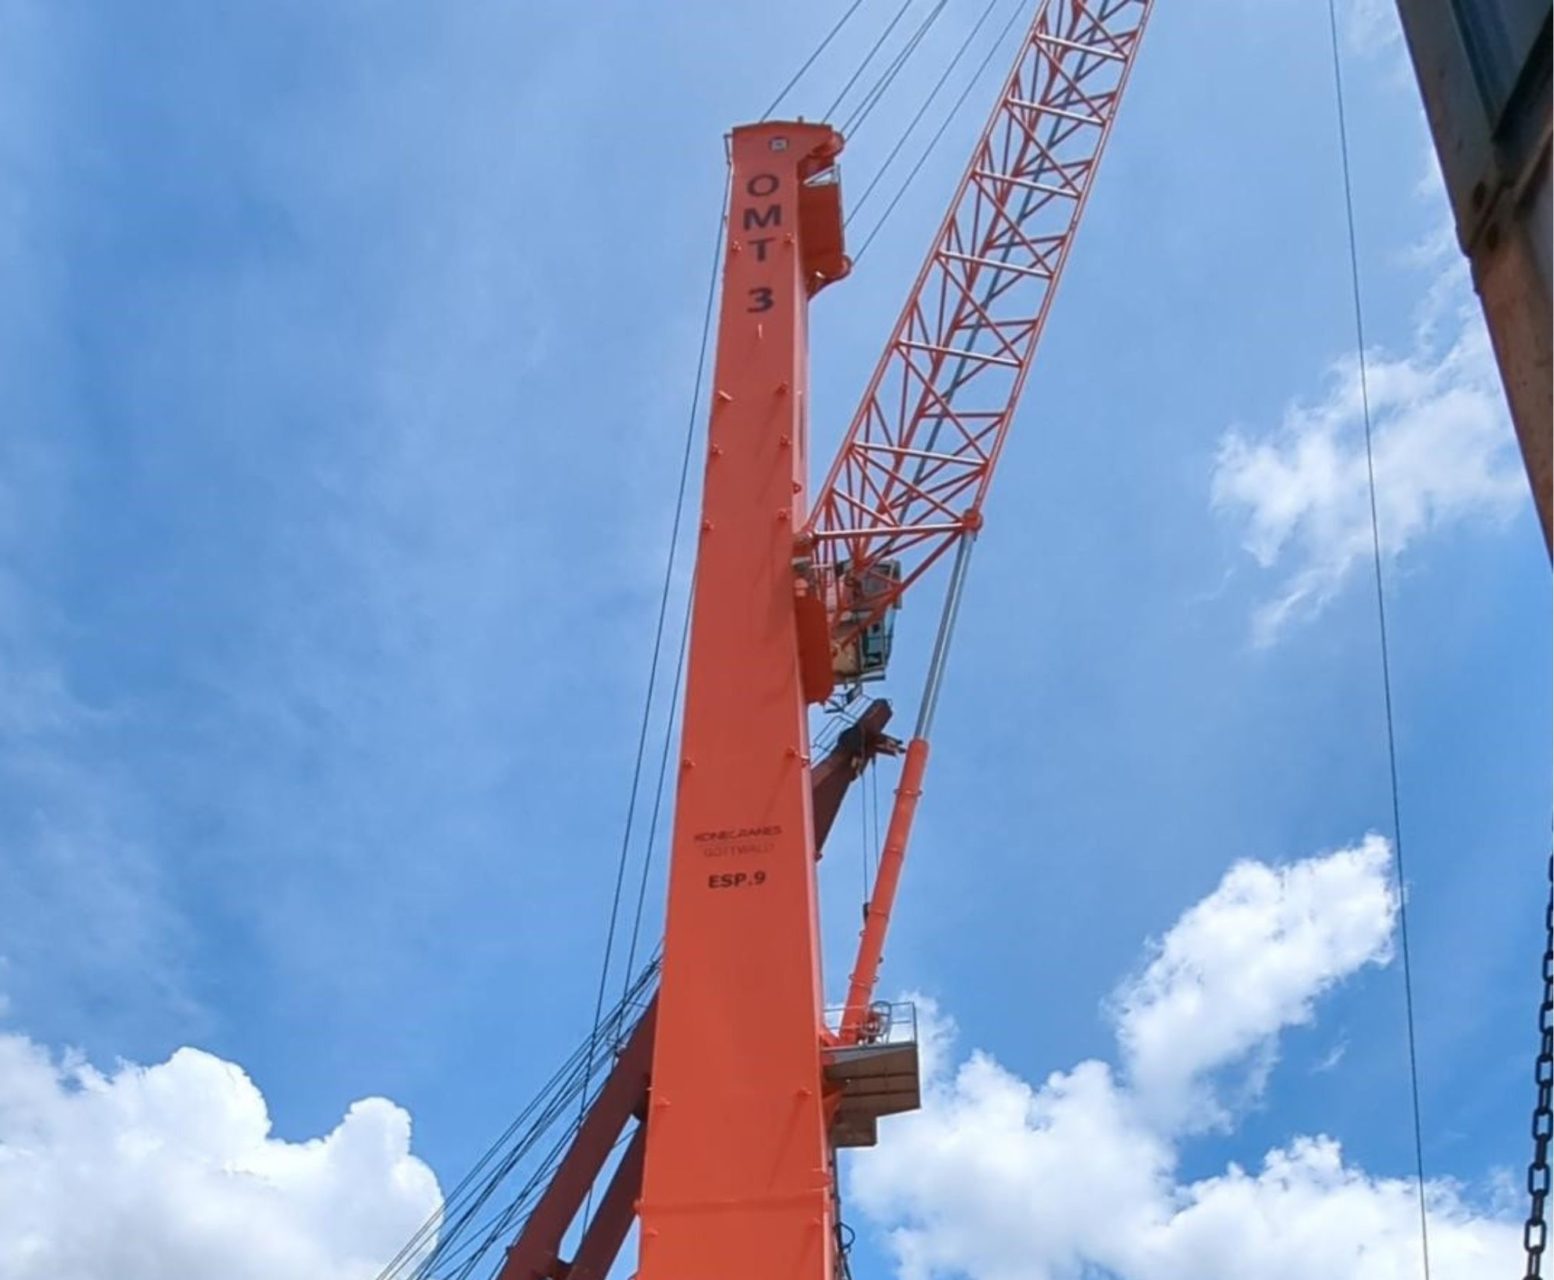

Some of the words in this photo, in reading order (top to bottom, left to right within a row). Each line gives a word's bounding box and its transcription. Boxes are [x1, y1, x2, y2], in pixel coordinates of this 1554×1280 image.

[744, 174, 781, 262] OMT
[747, 288, 774, 313] 3
[708, 870, 766, 889] ESP.9
